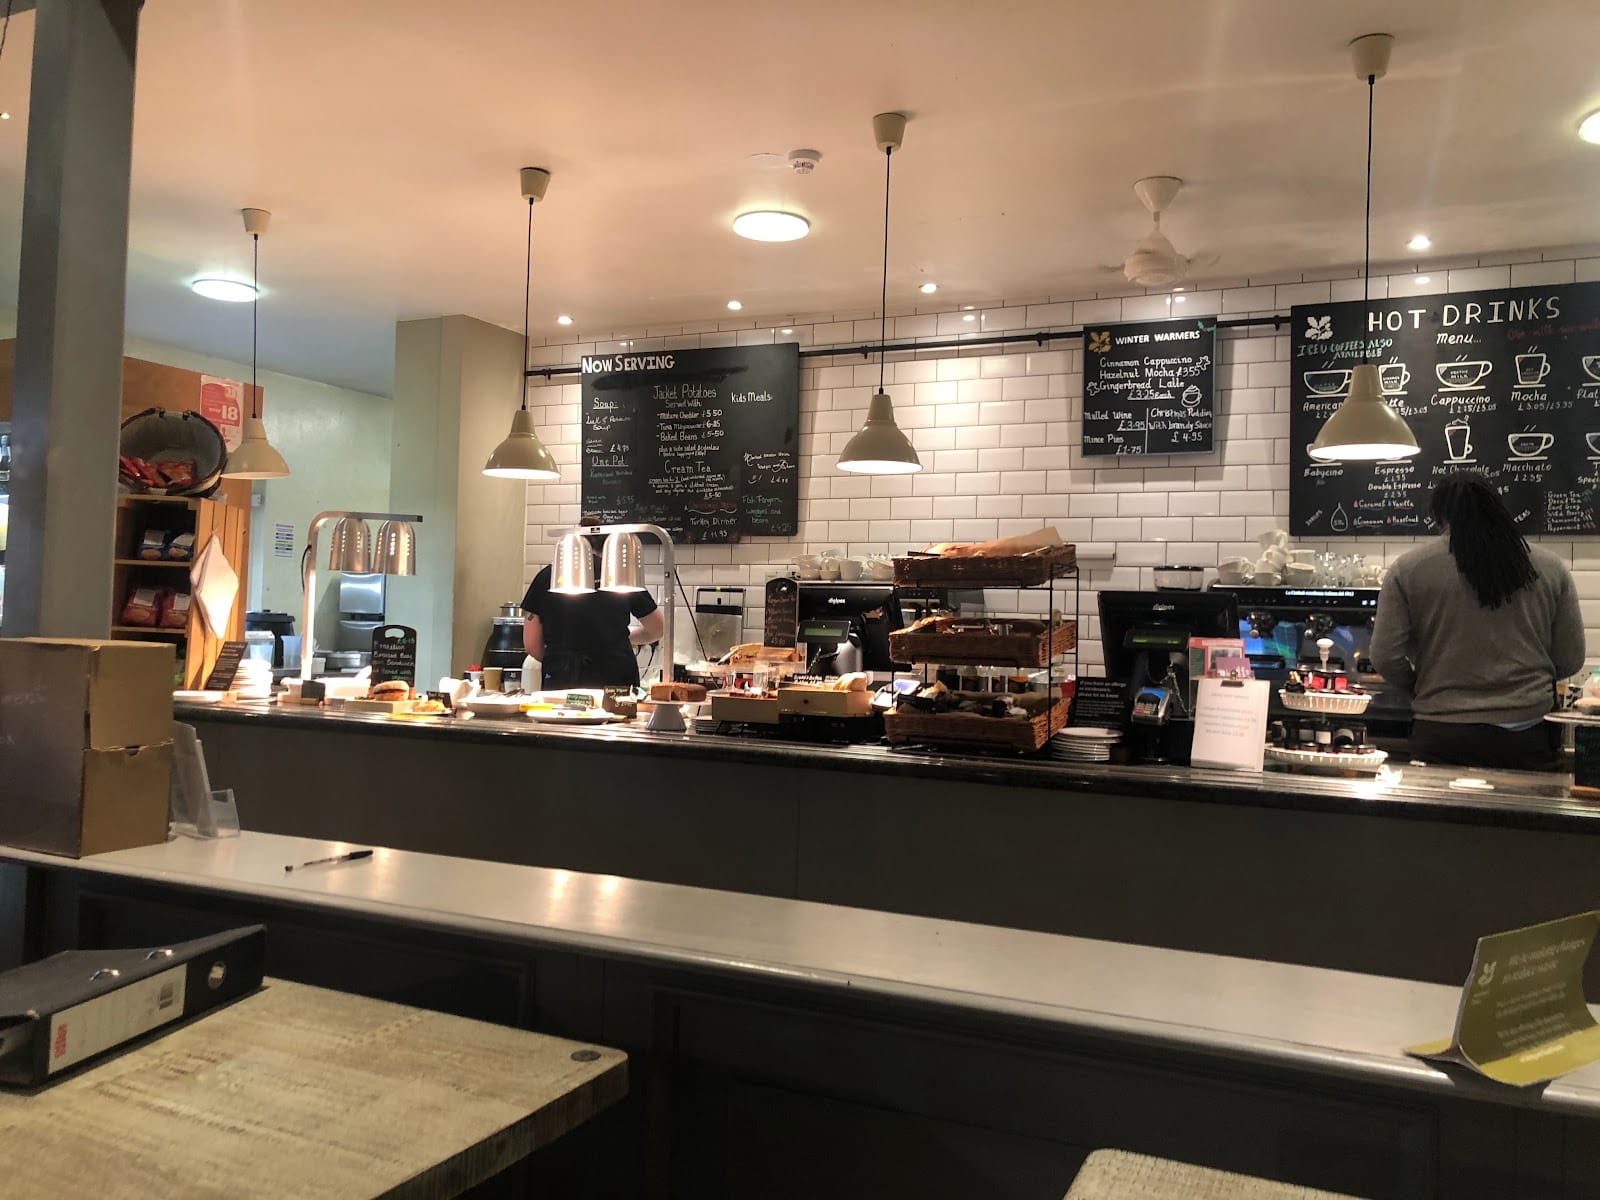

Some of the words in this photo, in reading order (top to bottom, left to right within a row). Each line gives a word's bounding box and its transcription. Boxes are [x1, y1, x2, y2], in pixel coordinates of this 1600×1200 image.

[1368, 309, 1427, 332] HOT
[1442, 296, 1560, 327] DRINKS
[1115, 335, 1150, 345] WINTER
[1154, 331, 1200, 342] WARMERS
[1367, 338, 1393, 350] ALSO
[615, 354, 675, 372] SERVING
[1100, 357, 1139, 367] Cinnamon
[1144, 356, 1192, 369] Cappuccino
[1100, 369, 1140, 379] Hazelnut
[1145, 368, 1175, 377] Mocha
[1100, 379, 1151, 393] Gingerbread
[1159, 378, 1184, 388] Latte
[653, 385, 678, 400] Jacket
[682, 384, 717, 399] Potatoes
[731, 392, 747, 404] Kids
[1511, 390, 1547, 401] Mocha
[1430, 393, 1491, 408] Cappuccino
[1084, 411, 1109, 420] Mulled
[1113, 411, 1132, 420] Wine
[1084, 435, 1104, 444] Mince
[1108, 434, 1124, 443] Pies
[664, 460, 694, 473] Cream
[695, 461, 712, 473] Tea
[1374, 466, 1415, 475] Espresso
[1503, 462, 1552, 472] Macchiato
[1303, 467, 1344, 479] Babycino
[1368, 483, 1392, 491] Double
[1393, 482, 1421, 492] Espresso
[1548, 491, 1567, 499] Green
[1358, 499, 1386, 507] Caramel
[1392, 499, 1414, 507] Vanilla
[1392, 515, 1419, 523] Hazelnut
